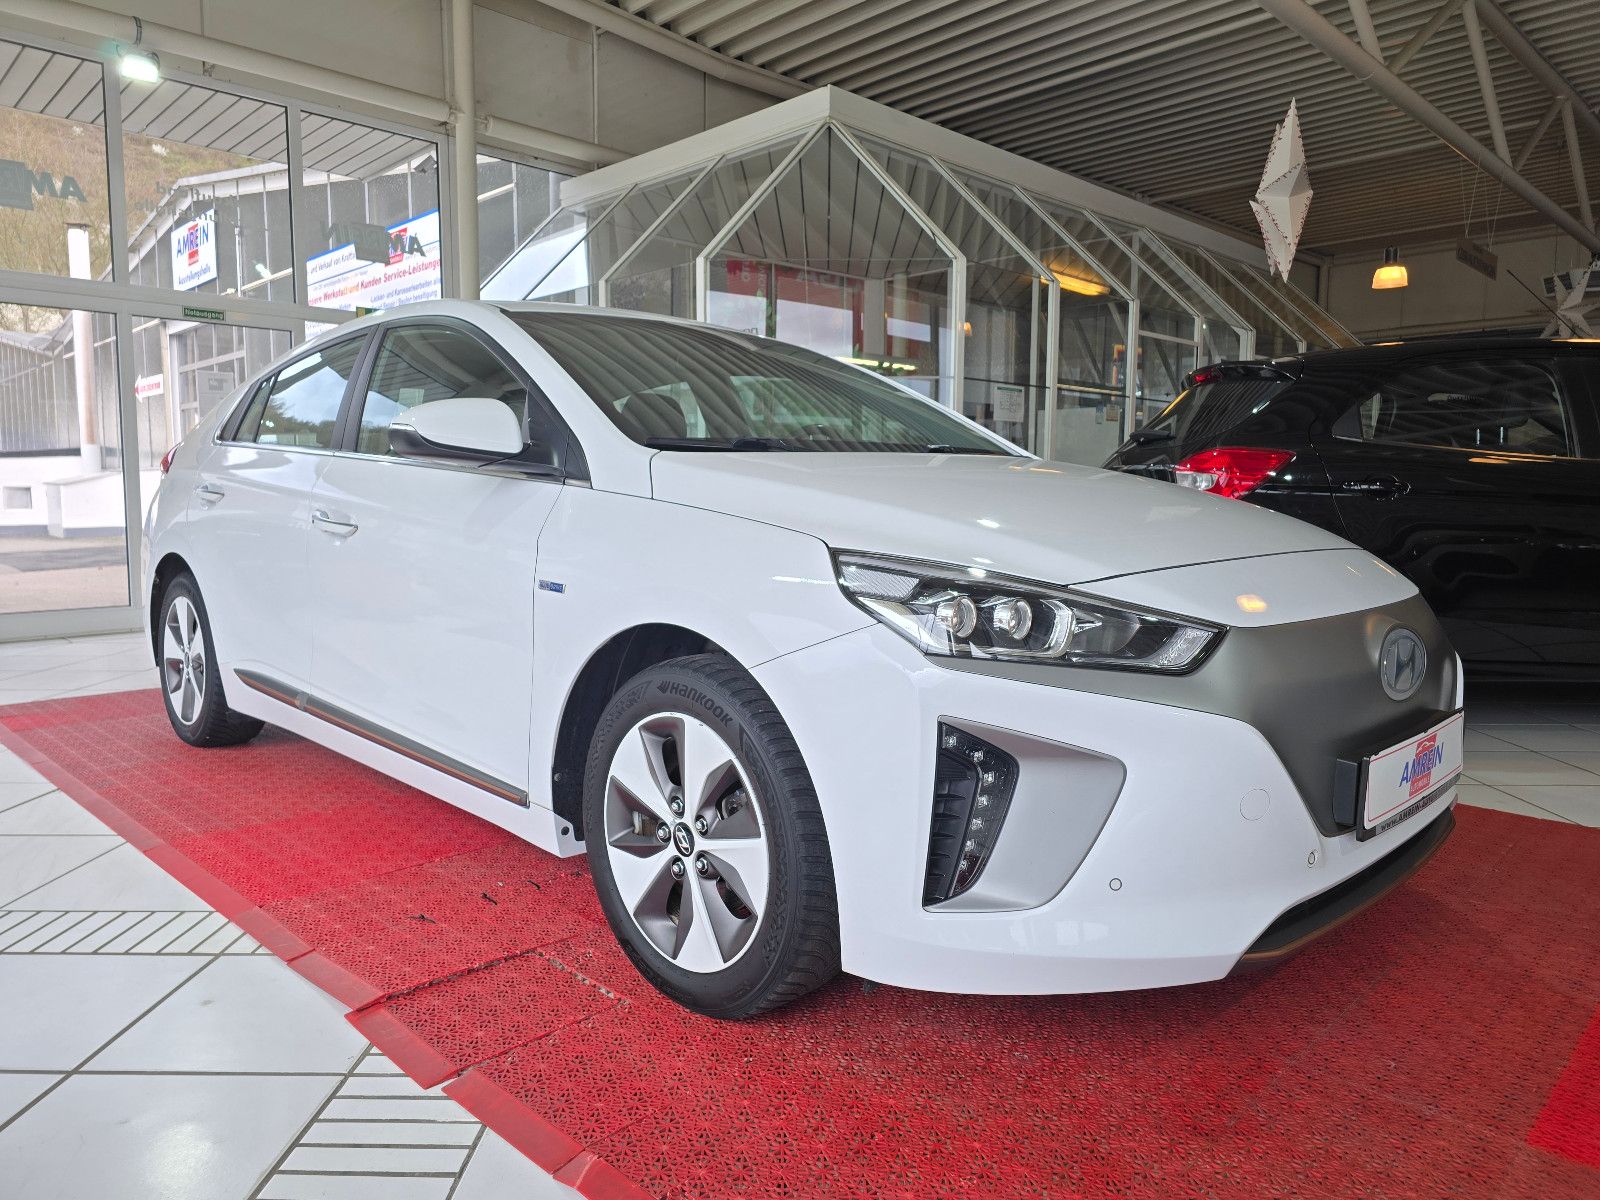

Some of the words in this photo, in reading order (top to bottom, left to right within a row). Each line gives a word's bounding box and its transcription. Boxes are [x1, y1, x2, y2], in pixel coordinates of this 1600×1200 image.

[177, 223, 209, 258] AMREIN
[360, 276, 381, 290] Kunden
[384, 258, 440, 283] Service-Leistunge
[185, 308, 224, 320] Notausgang
[1399, 742, 1444, 787] AMREIN
